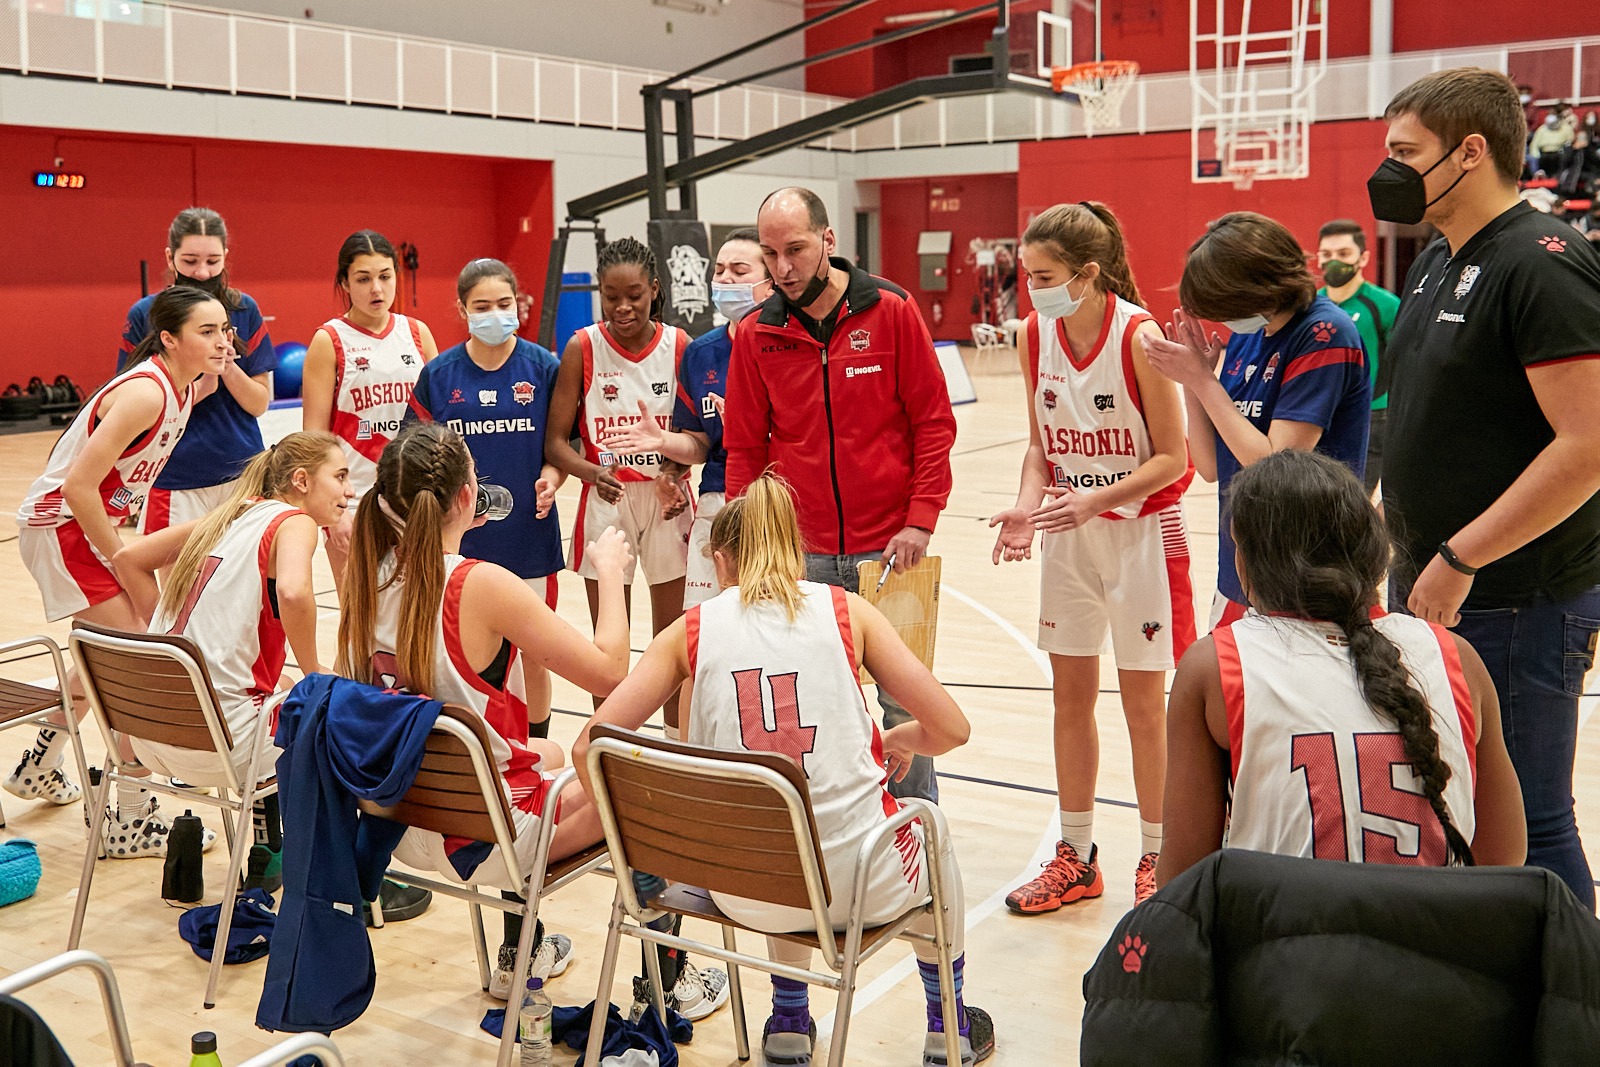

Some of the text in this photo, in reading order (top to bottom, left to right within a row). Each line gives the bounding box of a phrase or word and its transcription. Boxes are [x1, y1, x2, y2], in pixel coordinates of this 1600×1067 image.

[761, 343, 799, 353] KELME
[465, 418, 536, 435] INGEVEL
[619, 453, 668, 466] INGEV
[731, 667, 818, 780] 4
[1290, 731, 1450, 866] 15
